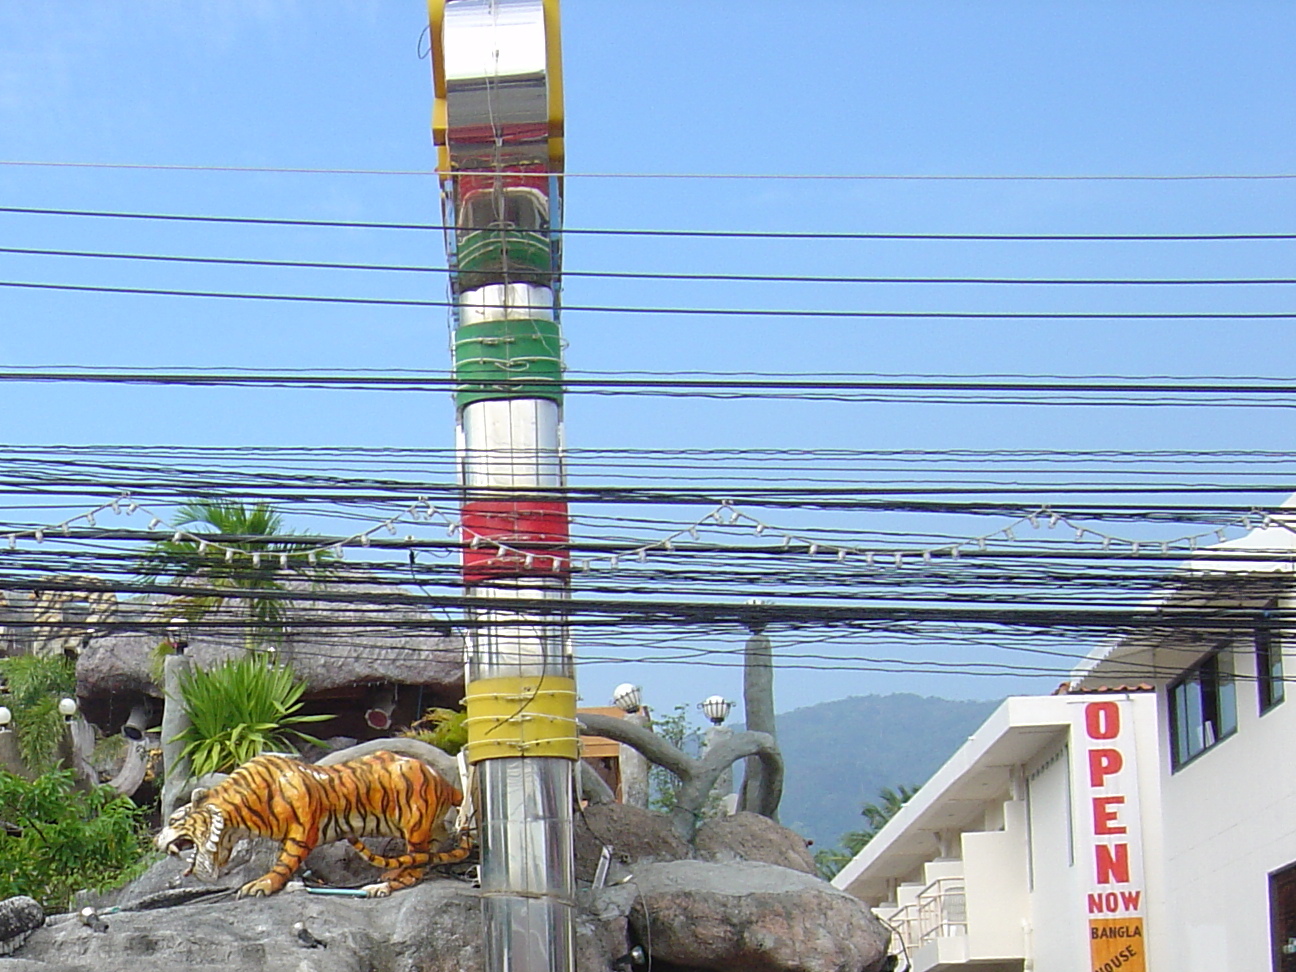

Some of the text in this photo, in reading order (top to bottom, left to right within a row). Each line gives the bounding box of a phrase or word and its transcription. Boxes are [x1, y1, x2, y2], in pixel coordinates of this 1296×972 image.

[1084, 701, 1130, 885] OPEN
[1087, 890, 1142, 914] NOW
[1091, 925, 1142, 940] BANGLA
